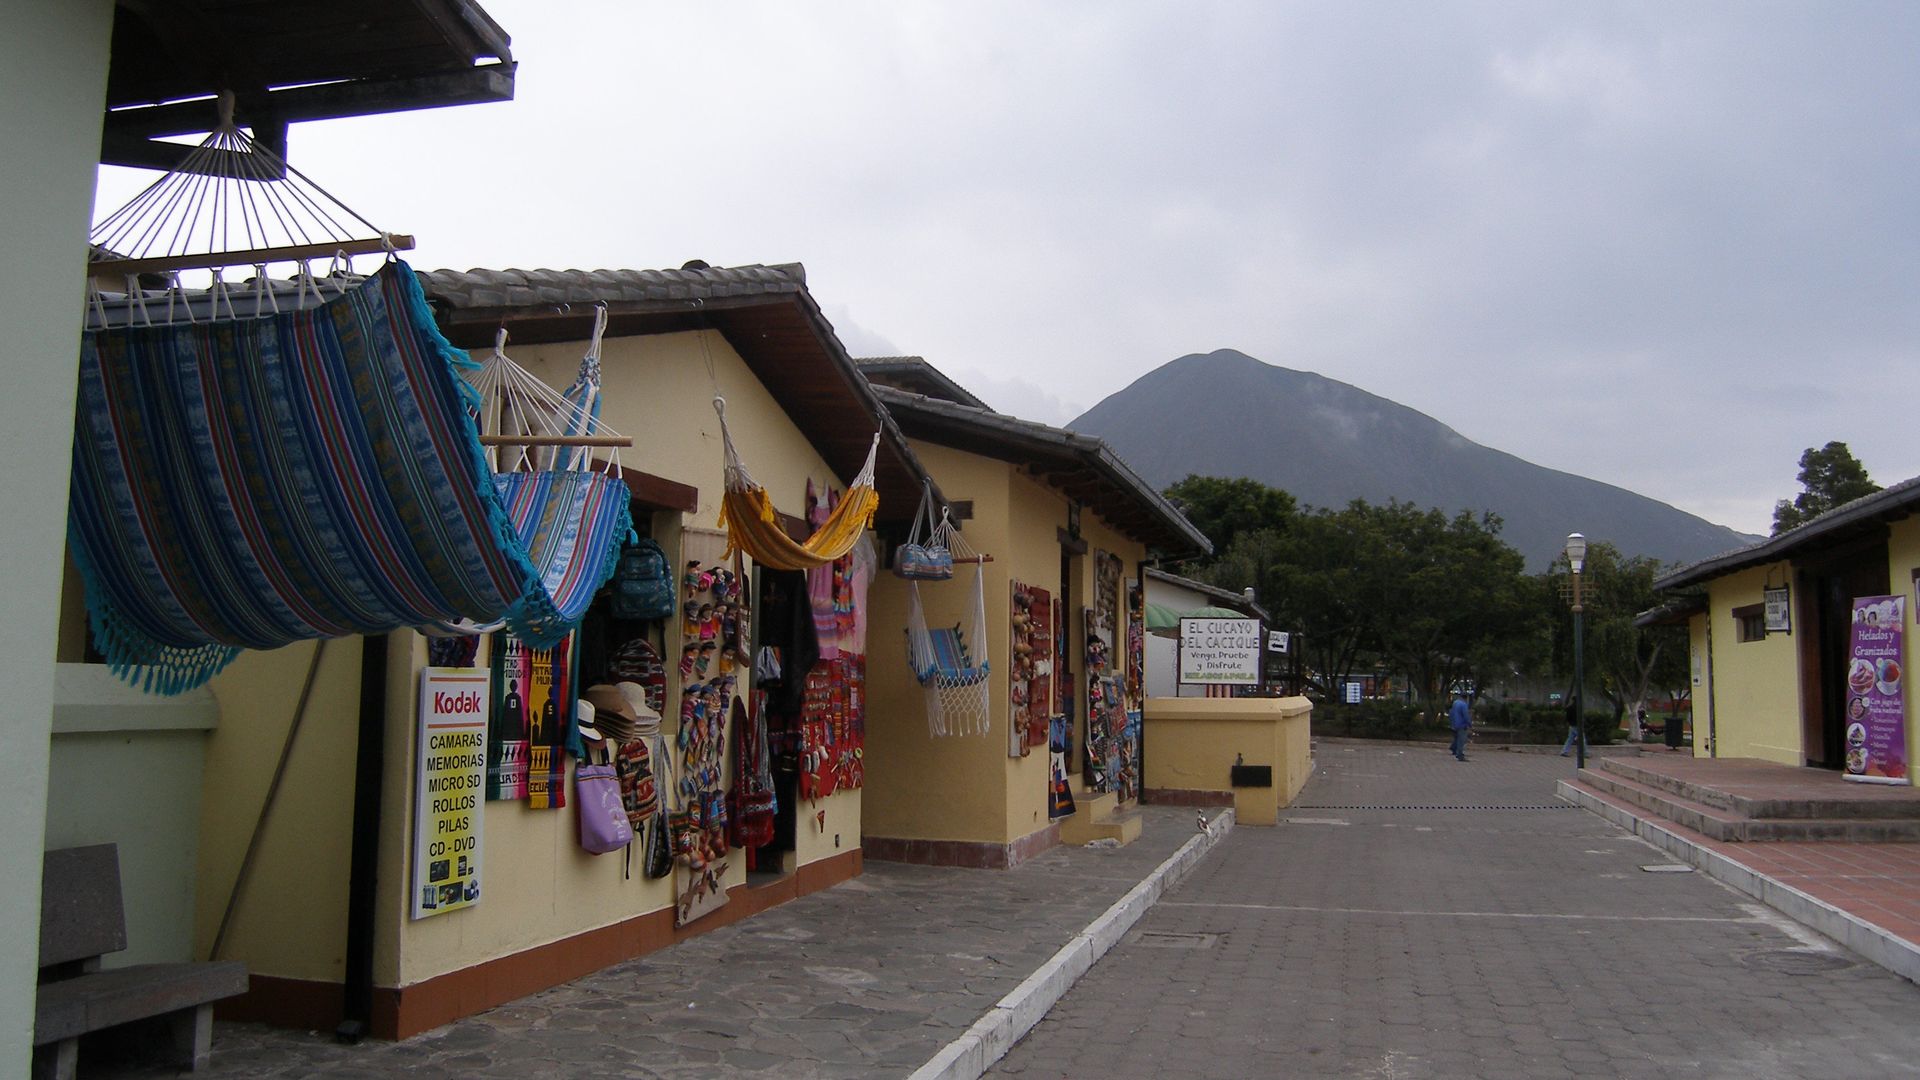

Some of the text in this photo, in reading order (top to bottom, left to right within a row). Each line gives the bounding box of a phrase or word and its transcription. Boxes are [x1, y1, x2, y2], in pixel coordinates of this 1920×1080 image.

[1189, 622, 1253, 634] EL CUCAYO
[1858, 629, 1895, 643] Helados y
[1180, 637, 1259, 649] DEL CACIQUE
[1854, 644, 1897, 656] Granizados
[1219, 651, 1249, 659] Pruebe
[1196, 661, 1242, 671] y Disfrute
[434, 691, 481, 714] Kodak
[430, 733, 483, 750] CAMARAS
[427, 754, 484, 771] MEMORIAS
[428, 776, 464, 793] MICRO
[467, 774, 481, 789] SD
[433, 795, 476, 814] ROLLOS
[438, 817, 469, 835] PILAS
[429, 841, 445, 857] CD
[454, 836, 476, 853] DVD
